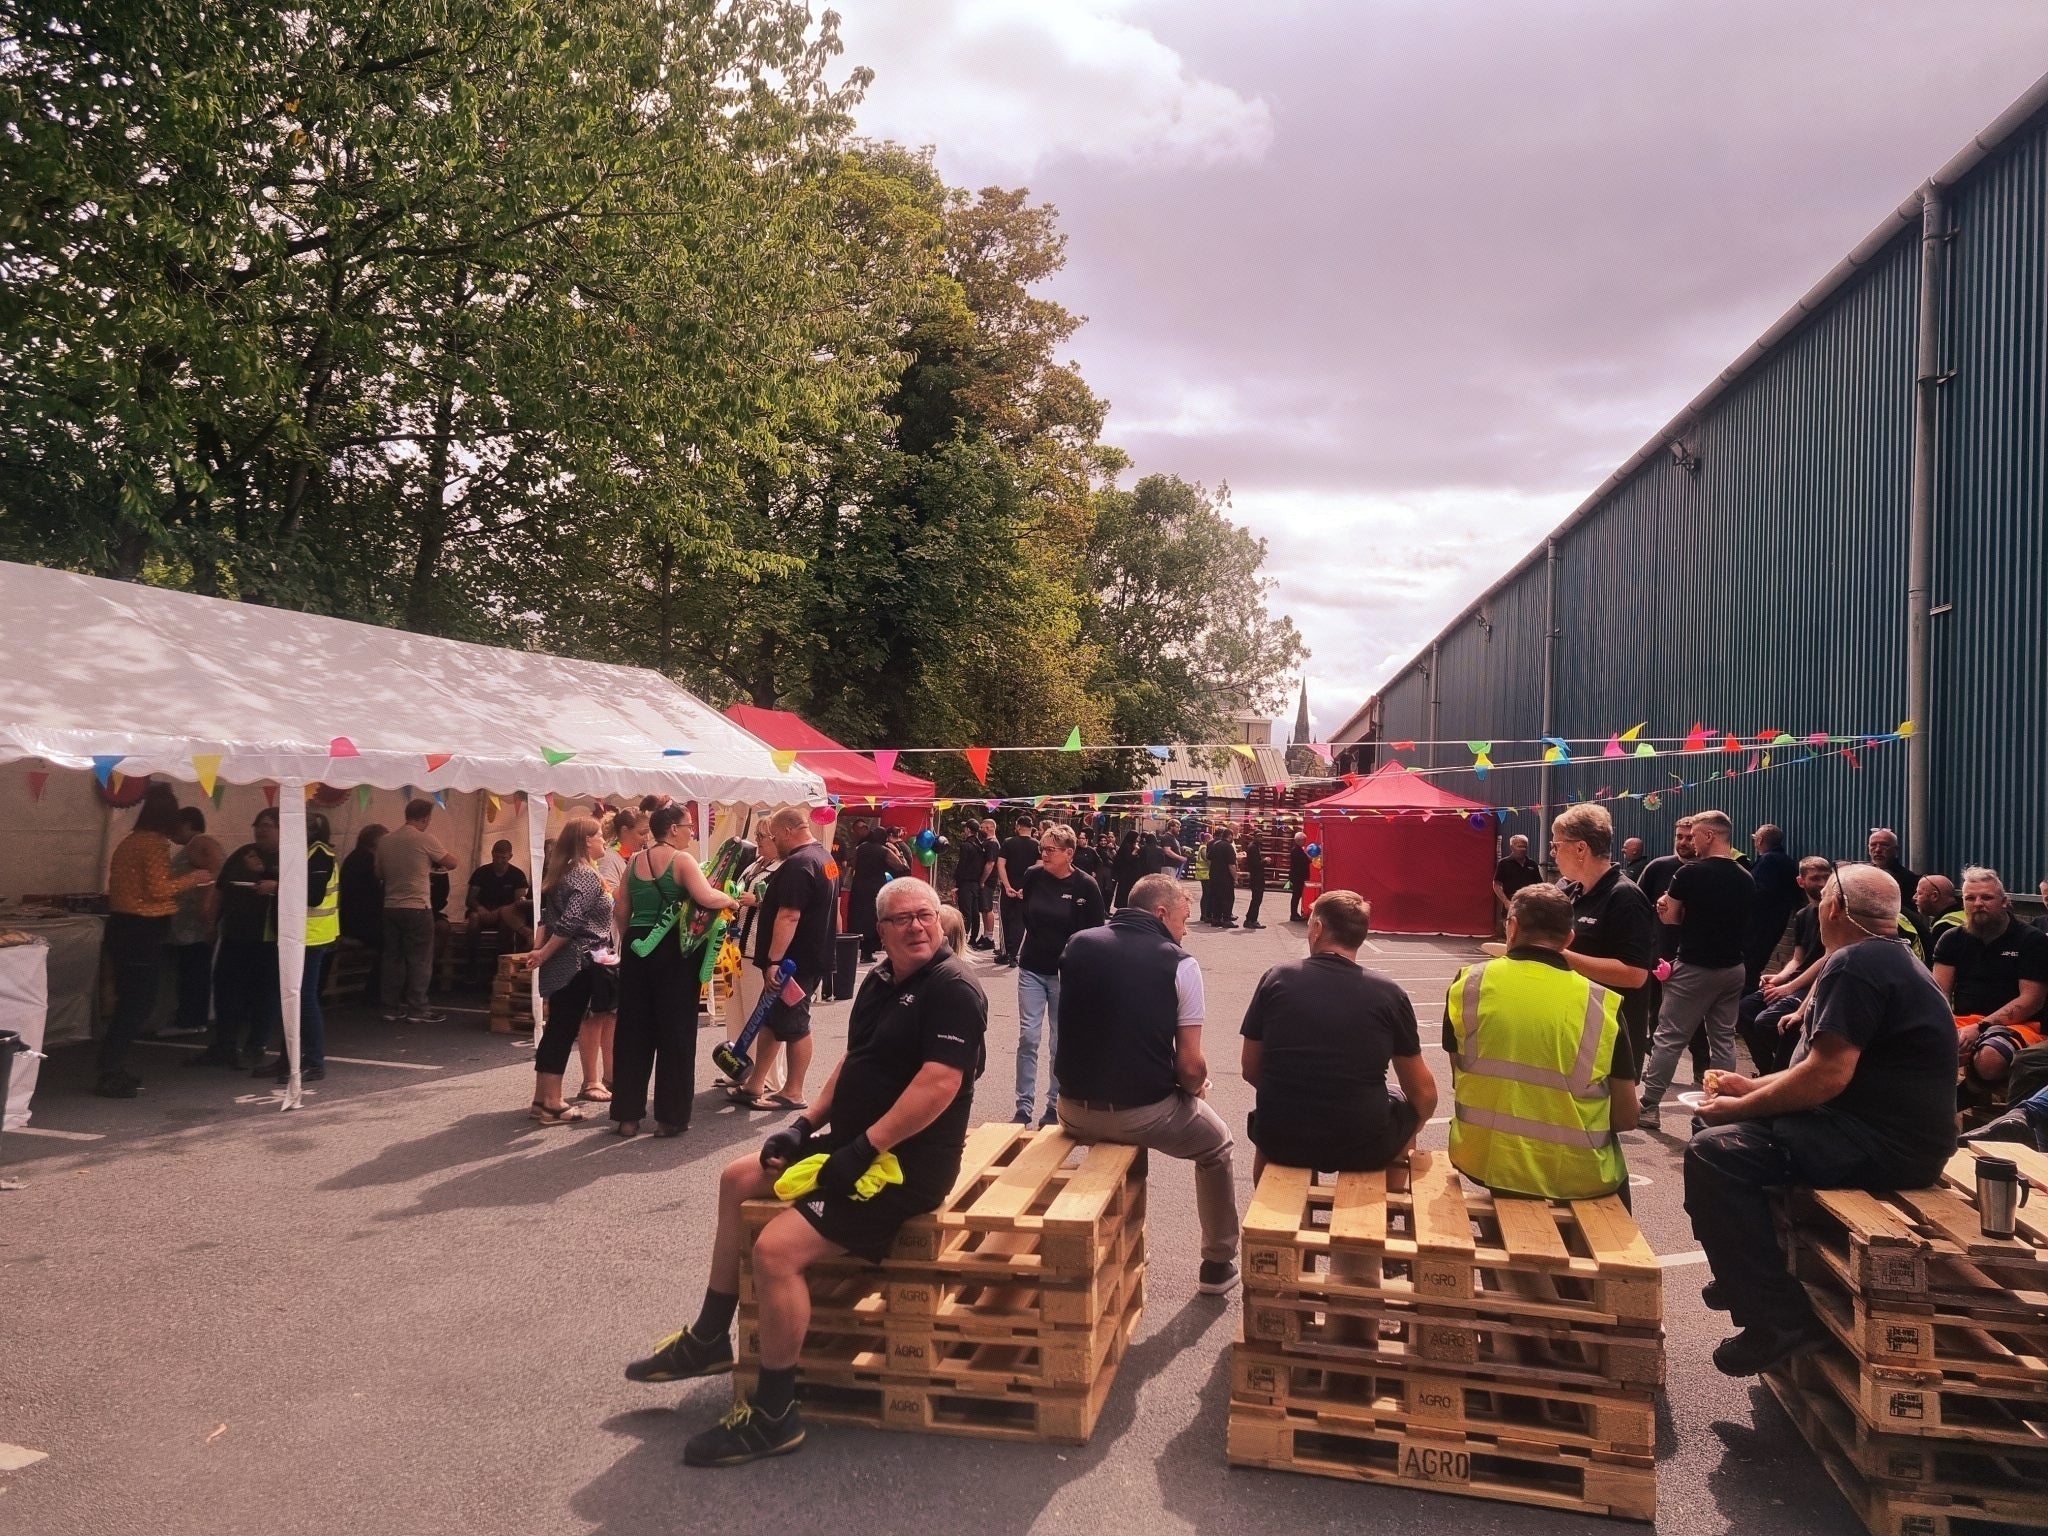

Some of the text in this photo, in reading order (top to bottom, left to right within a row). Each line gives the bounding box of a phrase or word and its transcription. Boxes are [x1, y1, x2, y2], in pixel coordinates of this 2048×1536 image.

[897, 1236, 927, 1249] AGRO
[1423, 1273, 1456, 1287] AGRO
[899, 1289, 928, 1302] AGRO
[1431, 1332, 1465, 1347] AGRO
[894, 1344, 923, 1358] AGRO
[889, 1398, 919, 1412] AGRO
[1419, 1393, 1451, 1408] AGRO
[1404, 1446, 1470, 1479] AGRO
